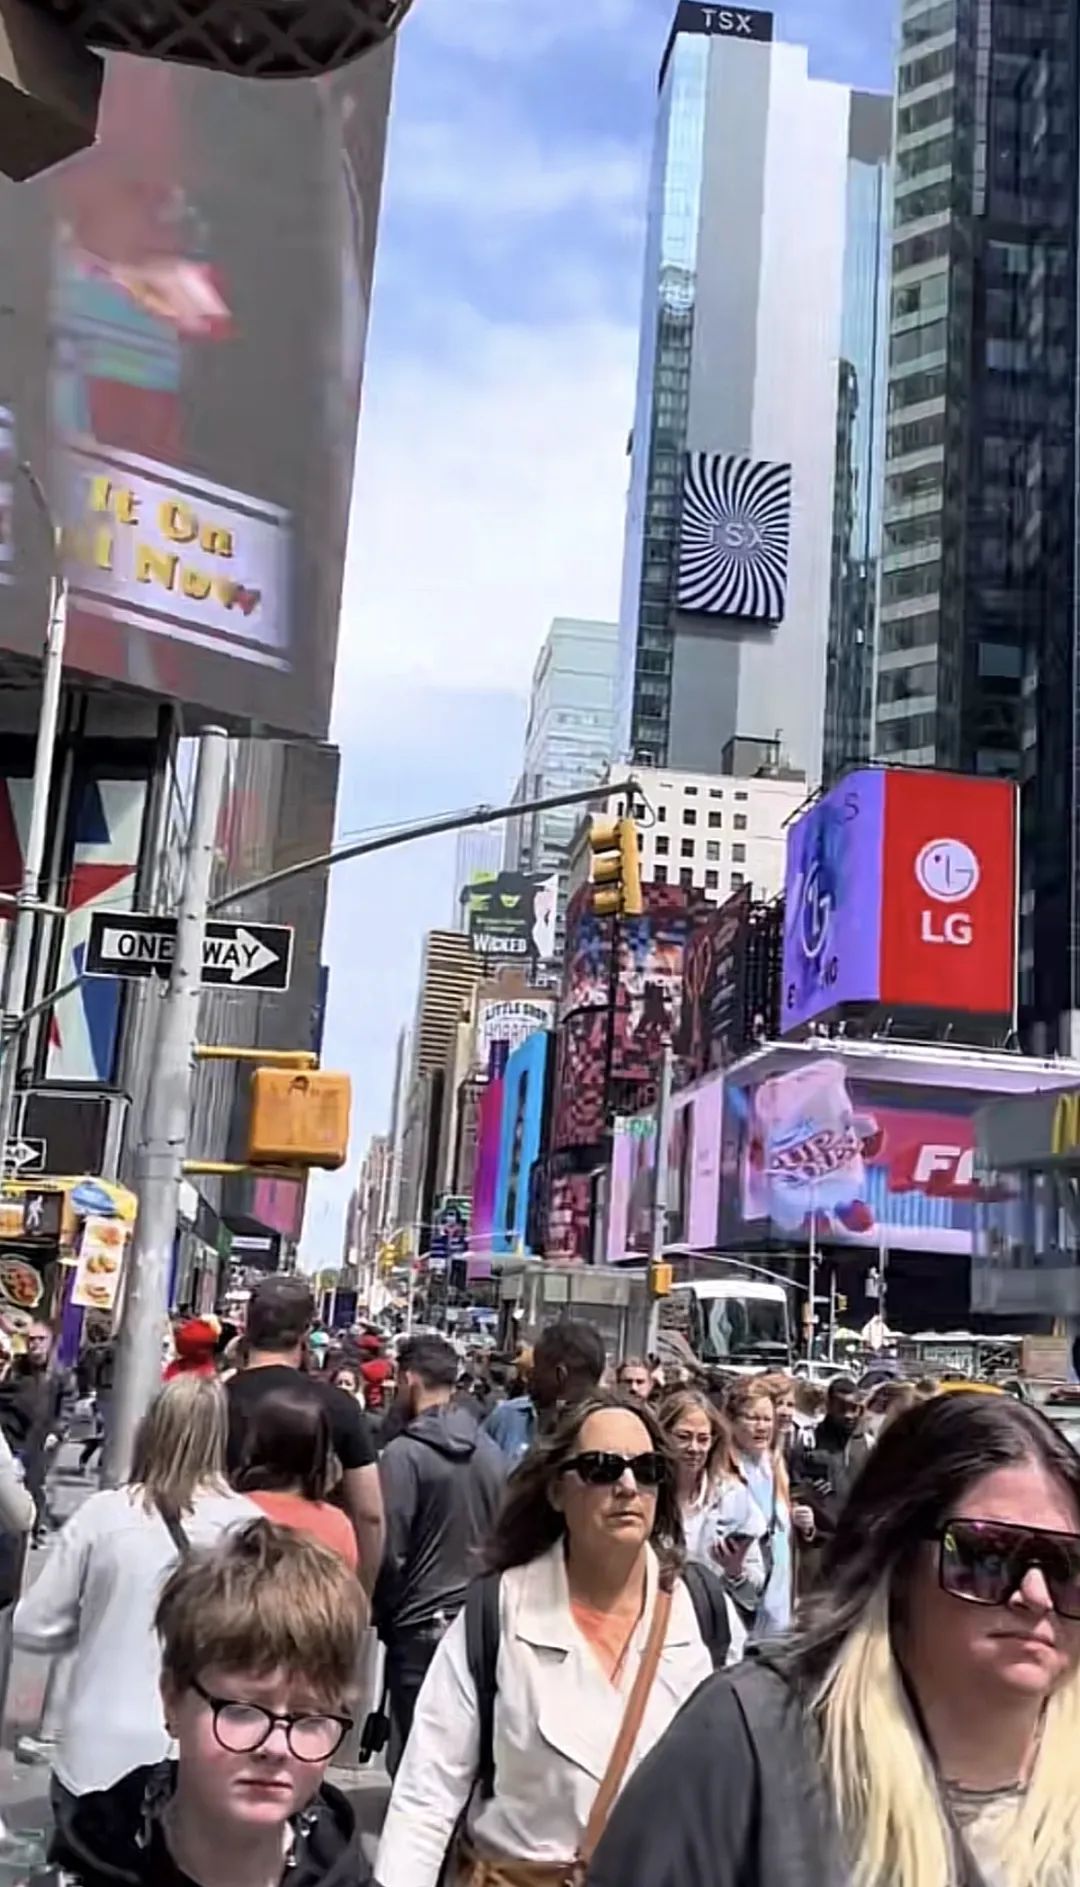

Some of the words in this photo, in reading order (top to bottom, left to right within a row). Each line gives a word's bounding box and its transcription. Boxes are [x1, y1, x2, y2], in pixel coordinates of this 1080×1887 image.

[701, 8, 751, 33] TSX
[159, 500, 233, 558] On
[921, 910, 973, 945] LG
[118, 934, 176, 960] ONE
[203, 941, 259, 968] WAY
[473, 933, 526, 953] WICKED
[485, 1002, 520, 1021] LITTLE
